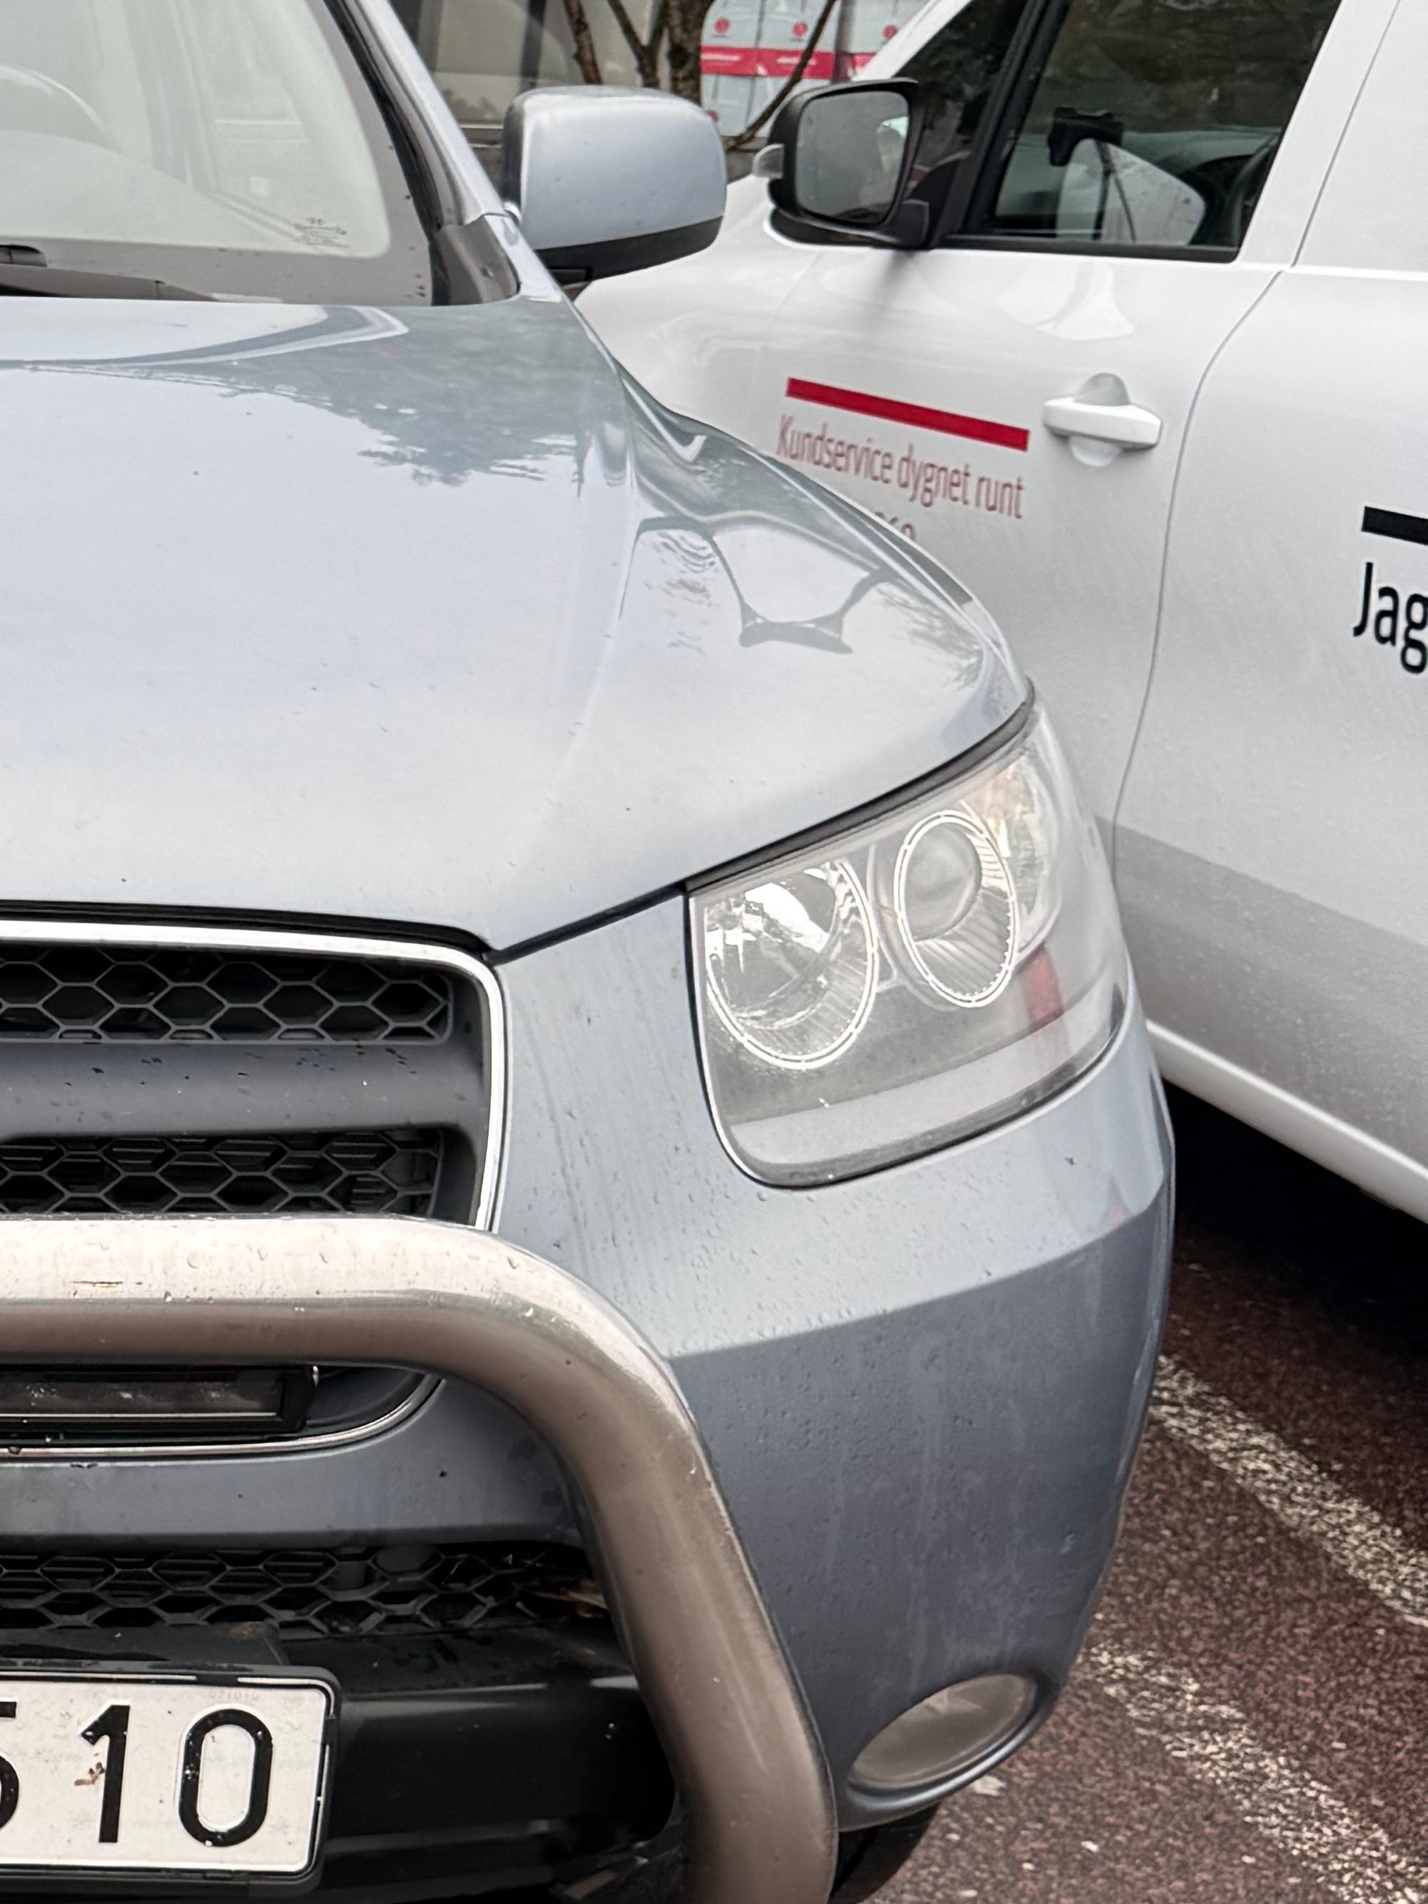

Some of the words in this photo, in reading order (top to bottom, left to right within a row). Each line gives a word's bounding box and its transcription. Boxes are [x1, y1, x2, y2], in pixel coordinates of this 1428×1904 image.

[777, 415, 893, 484] Kundservice
[897, 443, 971, 507] dygnet
[975, 476, 1024, 519] runt
